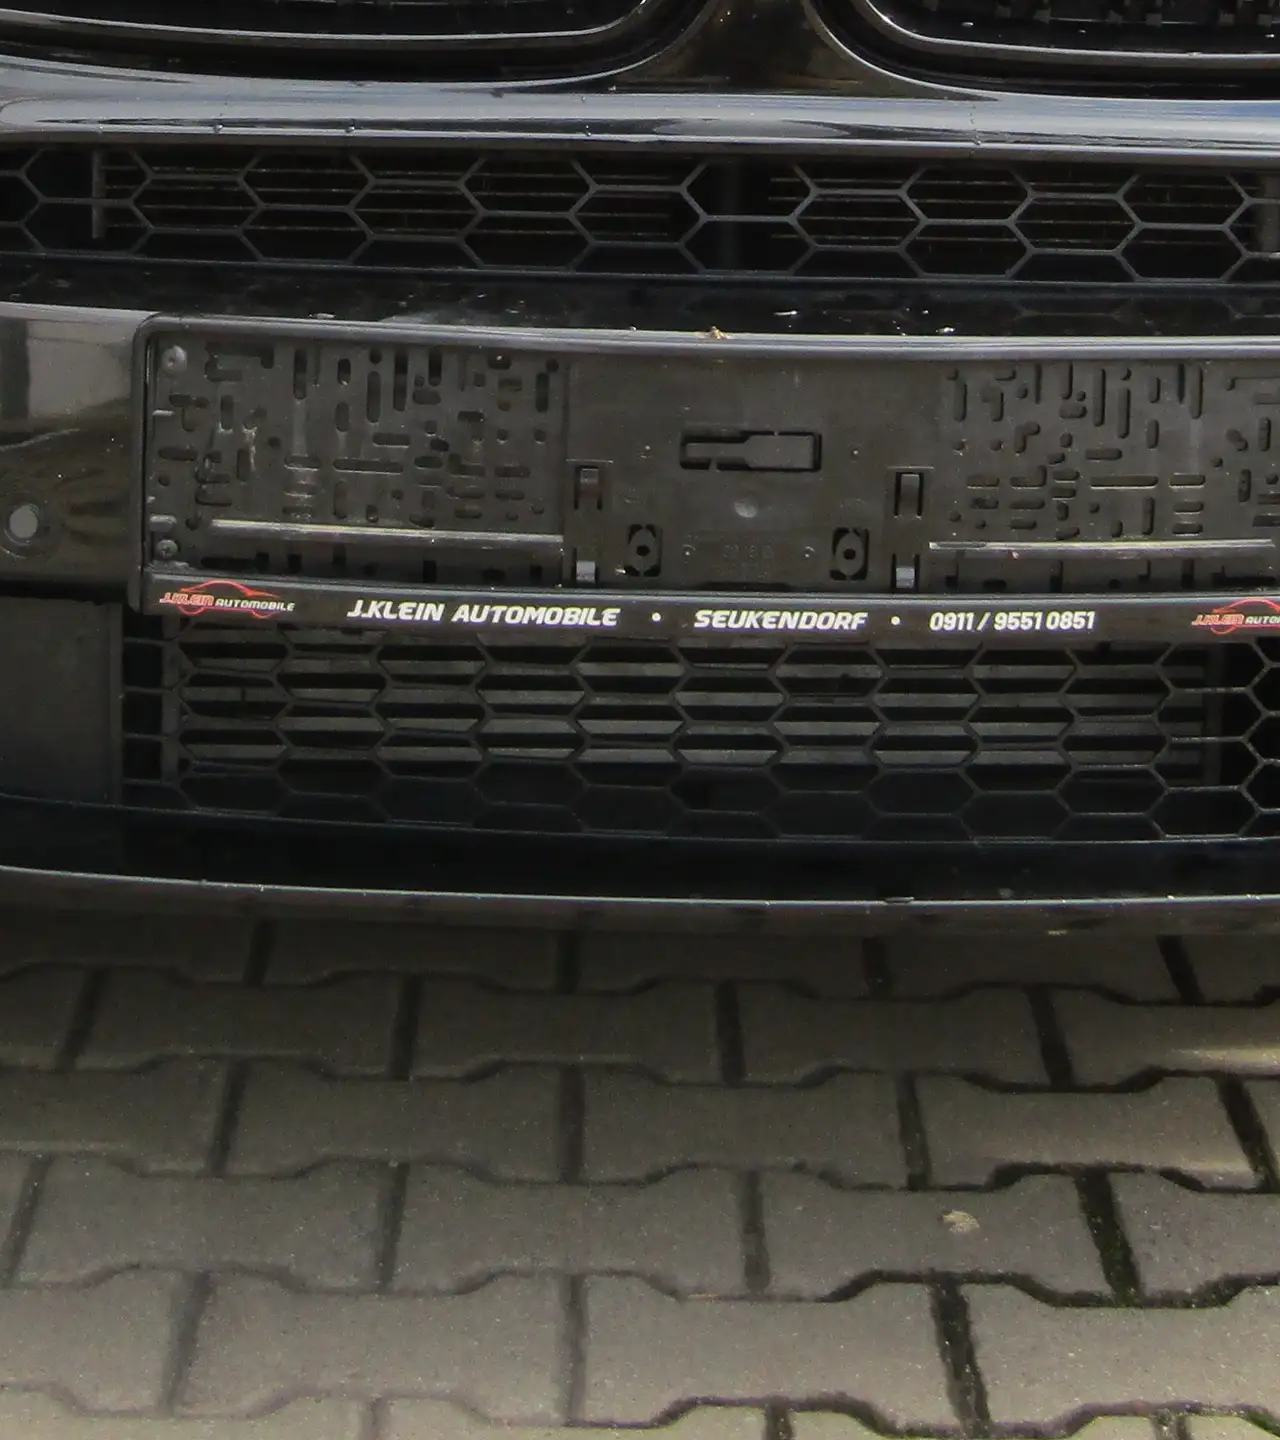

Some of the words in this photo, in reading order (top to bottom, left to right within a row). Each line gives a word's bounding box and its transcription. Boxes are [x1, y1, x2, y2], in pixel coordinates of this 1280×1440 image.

[215, 598, 296, 612] AUTOMOBILE
[346, 599, 446, 623] J.KLEIN
[450, 603, 621, 627] AUTOMOBILE
[693, 609, 869, 631] SEUKENDORF
[929, 611, 975, 631] 0911
